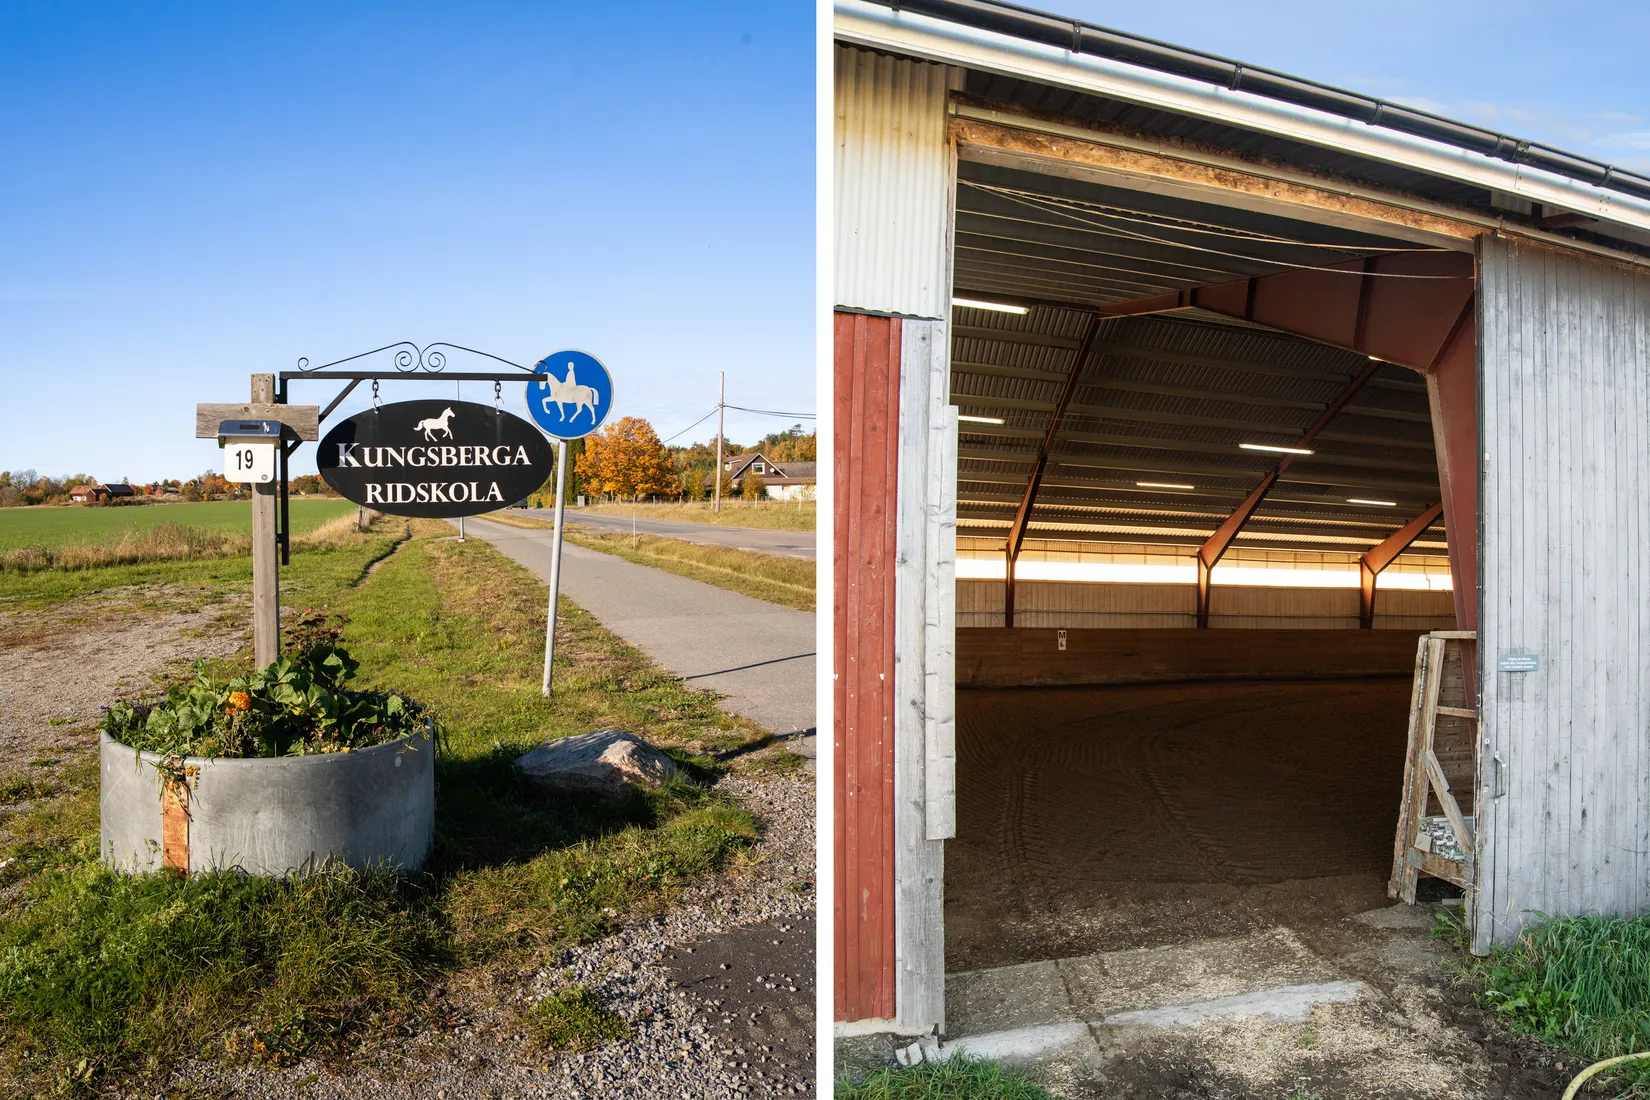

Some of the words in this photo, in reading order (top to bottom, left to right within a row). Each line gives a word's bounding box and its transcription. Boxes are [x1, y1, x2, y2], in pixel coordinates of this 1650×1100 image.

[235, 449, 254, 470] 19
[336, 442, 532, 468] KUNGSBERGA
[364, 481, 506, 504] RIDSKOLA
[1058, 631, 1066, 639] M
